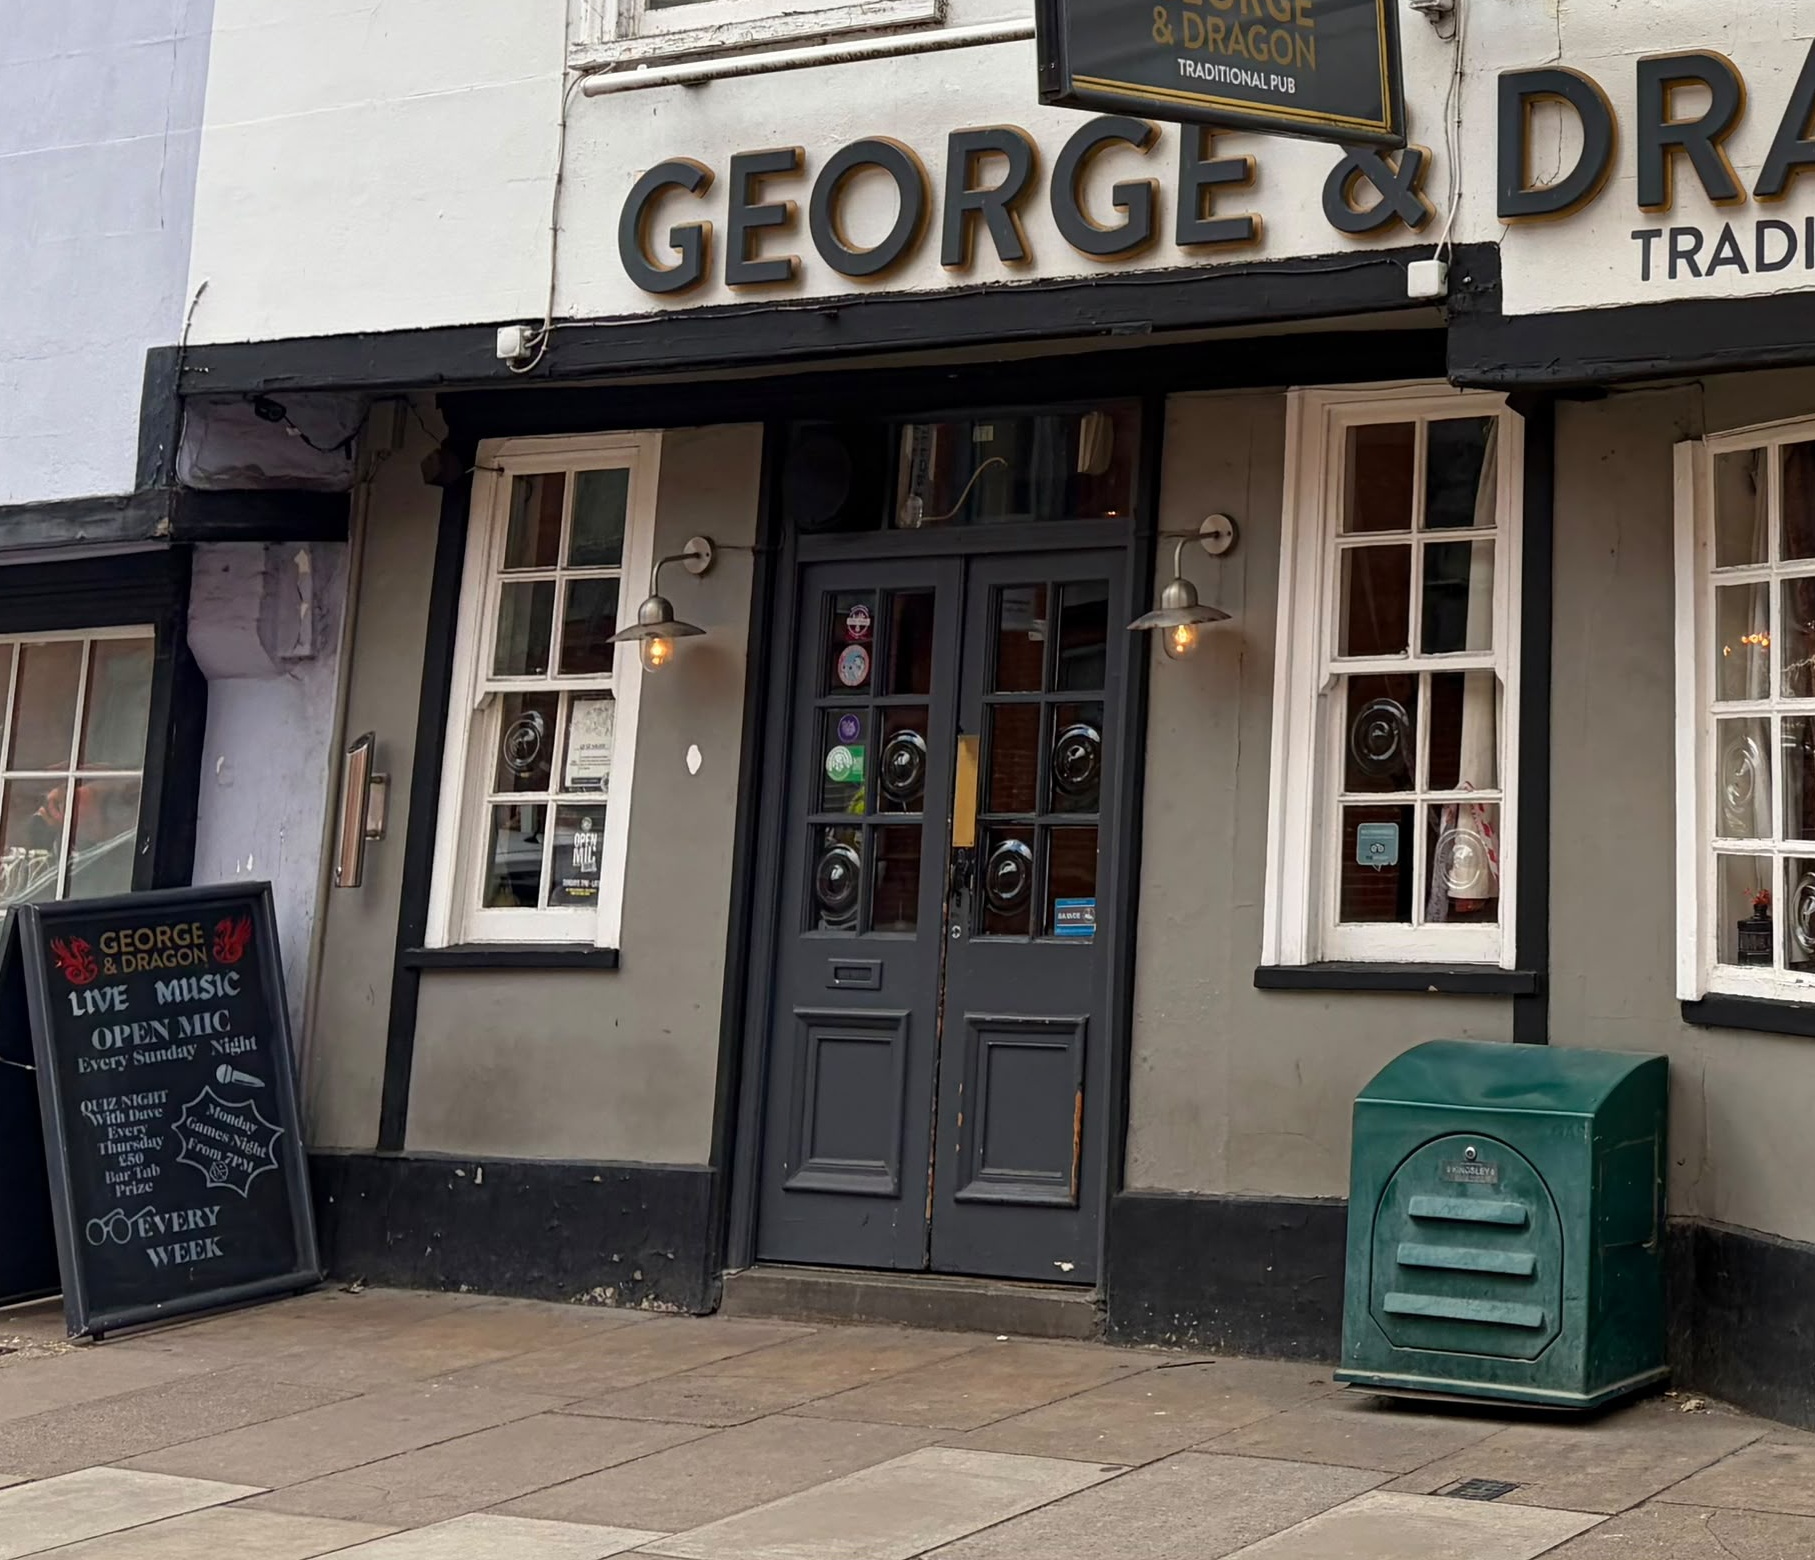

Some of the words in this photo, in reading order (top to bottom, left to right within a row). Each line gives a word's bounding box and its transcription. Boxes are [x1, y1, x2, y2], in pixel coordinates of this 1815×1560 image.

[1151, 5, 1174, 45] &
[1183, 10, 1316, 71] DRAGON
[1177, 58, 1268, 91] TRADITIONAL
[1270, 72, 1296, 94] PUB
[618, 114, 1262, 295] GEORGE
[1320, 144, 1434, 235] &
[100, 922, 205, 954] GEORGE
[104, 957, 117, 974] &
[122, 946, 208, 973] DRAGON
[69, 984, 129, 1016] LIVE
[154, 971, 241, 1005] MUSIC
[91, 1018, 170, 1051] OPEN
[177, 1009, 231, 1038] MIC
[77, 1054, 129, 1073] Every
[133, 1044, 197, 1065] Sunday
[210, 1035, 257, 1056] Night
[80, 1097, 118, 1114] QUIZ
[121, 1090, 168, 1108] NIGHT
[82, 1109, 125, 1126] With
[129, 1108, 163, 1122] Dave
[107, 1124, 148, 1140] Every
[206, 1103, 258, 1135] Monday
[97, 1135, 164, 1156] Thursday
[186, 1116, 230, 1143] Games
[230, 1134, 267, 1158] Night
[118, 1152, 144, 1167] £50
[187, 1137, 222, 1160] From
[225, 1152, 254, 1174] 7PM
[105, 1170, 131, 1184] Bar
[116, 1181, 153, 1197] Prize
[138, 1206, 221, 1238] EVERY
[146, 1236, 224, 1269] WEEK
